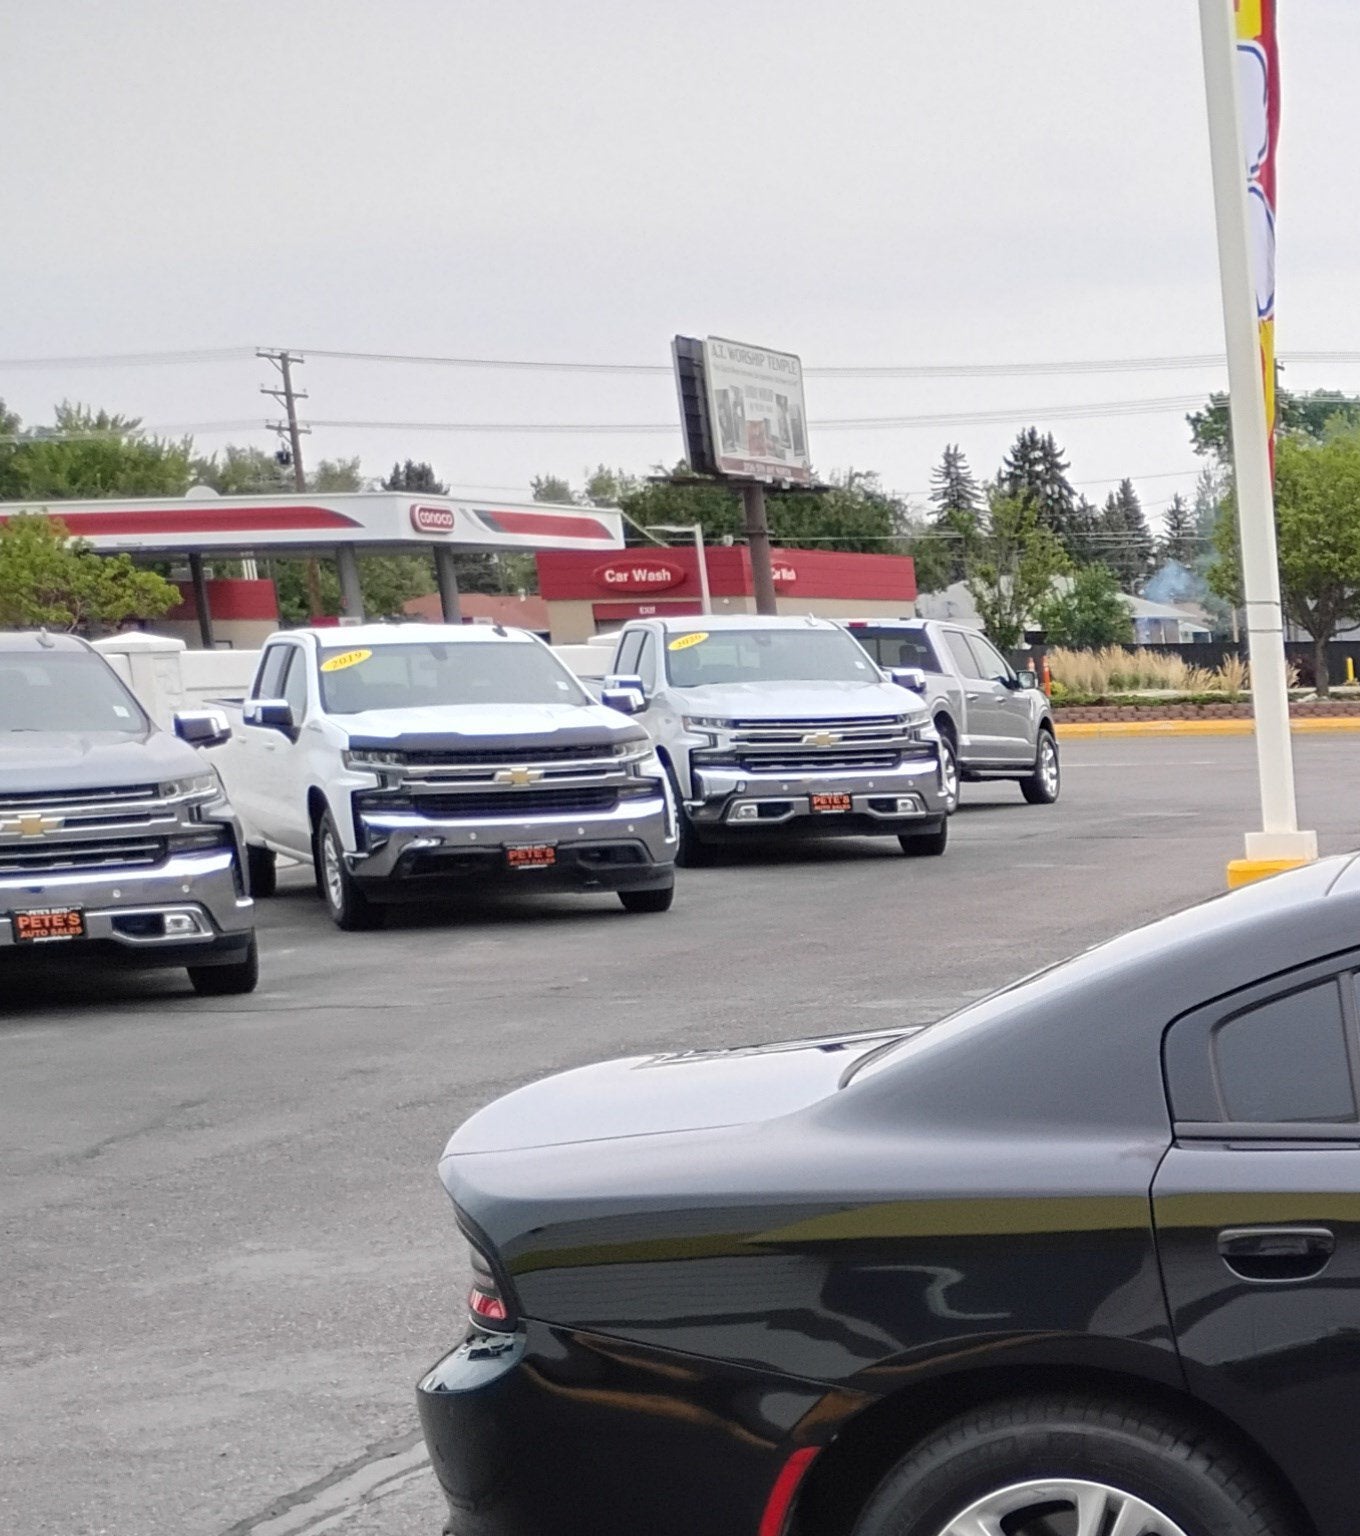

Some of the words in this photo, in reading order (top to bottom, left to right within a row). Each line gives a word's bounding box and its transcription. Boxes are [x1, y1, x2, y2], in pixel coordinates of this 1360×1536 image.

[767, 354, 798, 375] TEMPLE
[604, 569, 629, 582] Car
[632, 568, 671, 581] Wash
[18, 912, 81, 928] PETE'S
[21, 929, 49, 938] AUTO
[50, 927, 83, 936] SALES
